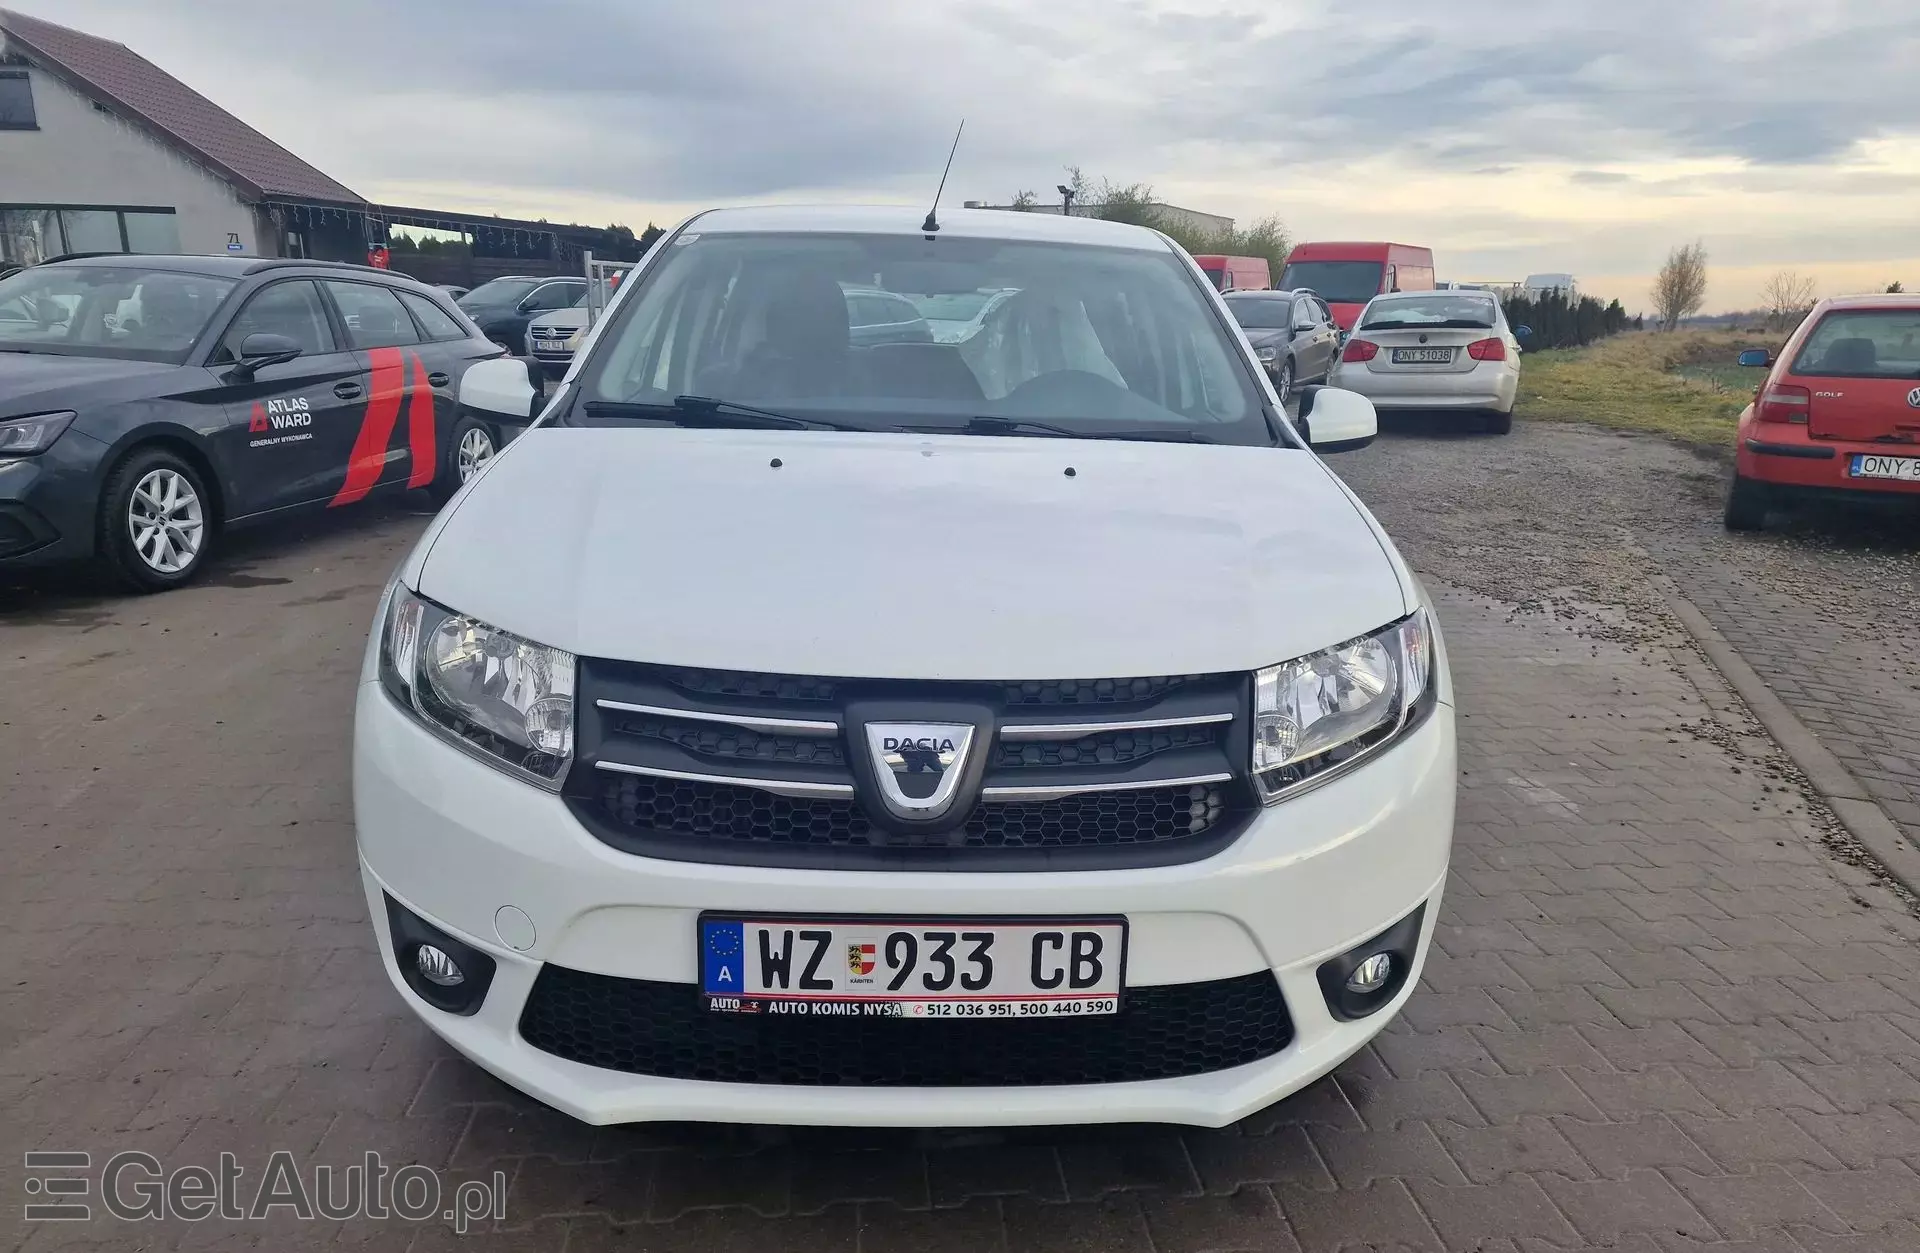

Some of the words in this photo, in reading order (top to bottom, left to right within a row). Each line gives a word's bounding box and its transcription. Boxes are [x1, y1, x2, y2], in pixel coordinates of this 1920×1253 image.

[227, 232, 241, 244] 71
[1398, 350, 1417, 361] ONY
[1419, 350, 1450, 361] 51038
[267, 397, 309, 414] ATLAS
[270, 412, 312, 429] WARD
[249, 437, 280, 447] GENERALNY
[1864, 457, 1906, 475] ONY
[883, 737, 955, 751] DACIA
[758, 929, 834, 990] WZ
[885, 931, 995, 991] 933
[1030, 931, 1104, 990] CB
[717, 965, 733, 982] A
[710, 997, 741, 1009] AUTO
[768, 1001, 808, 1015] AUTO
[811, 1002, 860, 1016] KOMIS
[863, 1003, 903, 1017] NYSA
[926, 1003, 951, 1016] 512
[956, 1003, 984, 1016] 036
[988, 1003, 1016, 1017] 951,
[1020, 1002, 1048, 1015] 500
[1052, 1001, 1082, 1014] 440
[1086, 1000, 1114, 1013] 590
